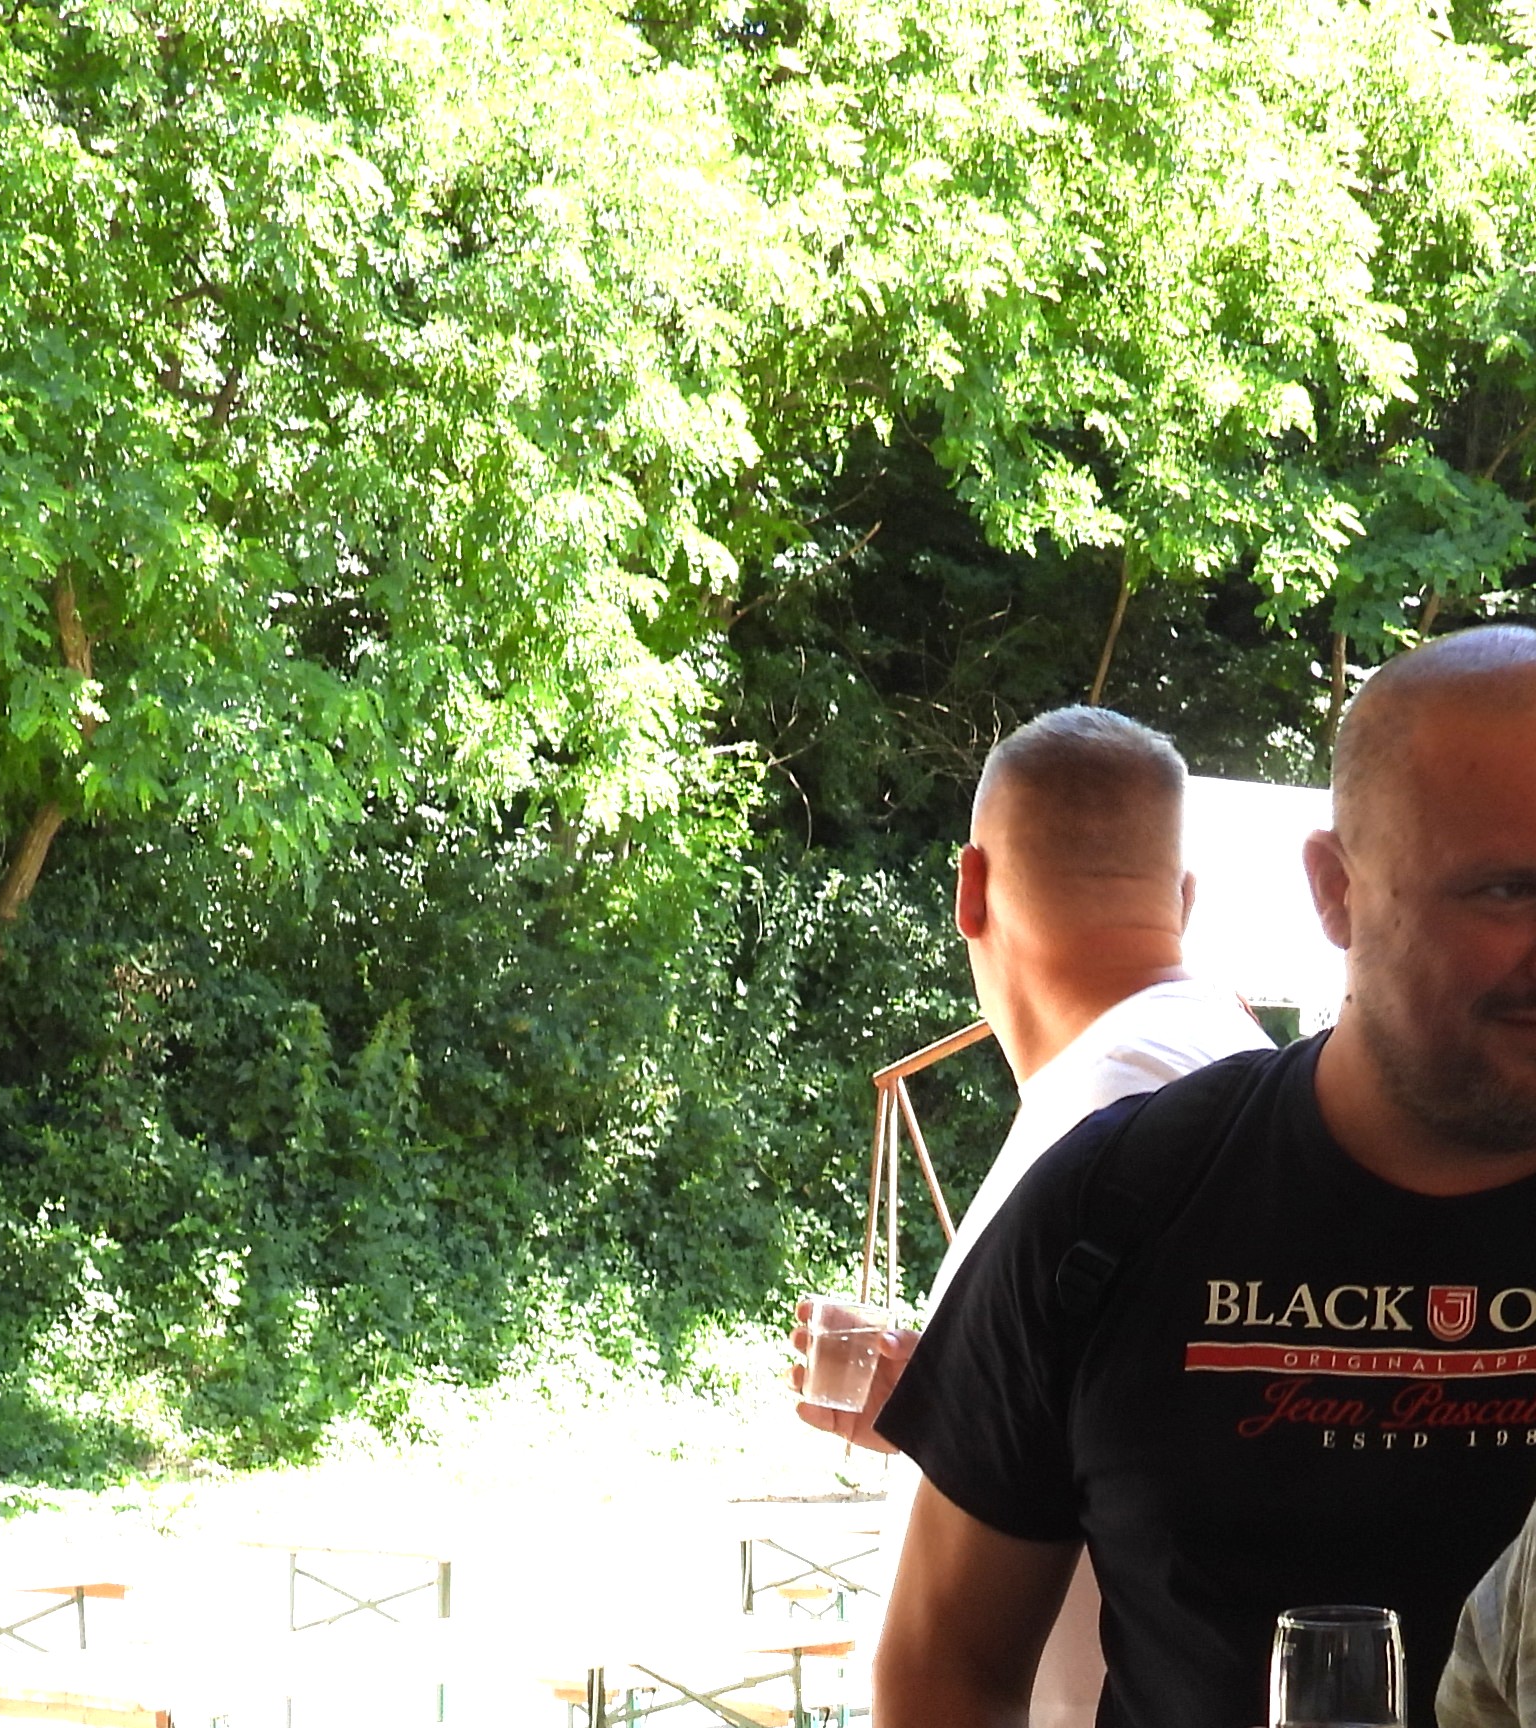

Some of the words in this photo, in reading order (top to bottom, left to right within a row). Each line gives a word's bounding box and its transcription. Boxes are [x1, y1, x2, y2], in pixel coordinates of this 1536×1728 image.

[1205, 1281, 1413, 1331] BLACK
[1283, 1352, 1446, 1372] ORIGINAL
[1237, 1378, 1373, 1437] Jean
[1322, 1430, 1428, 1448] ESTD
